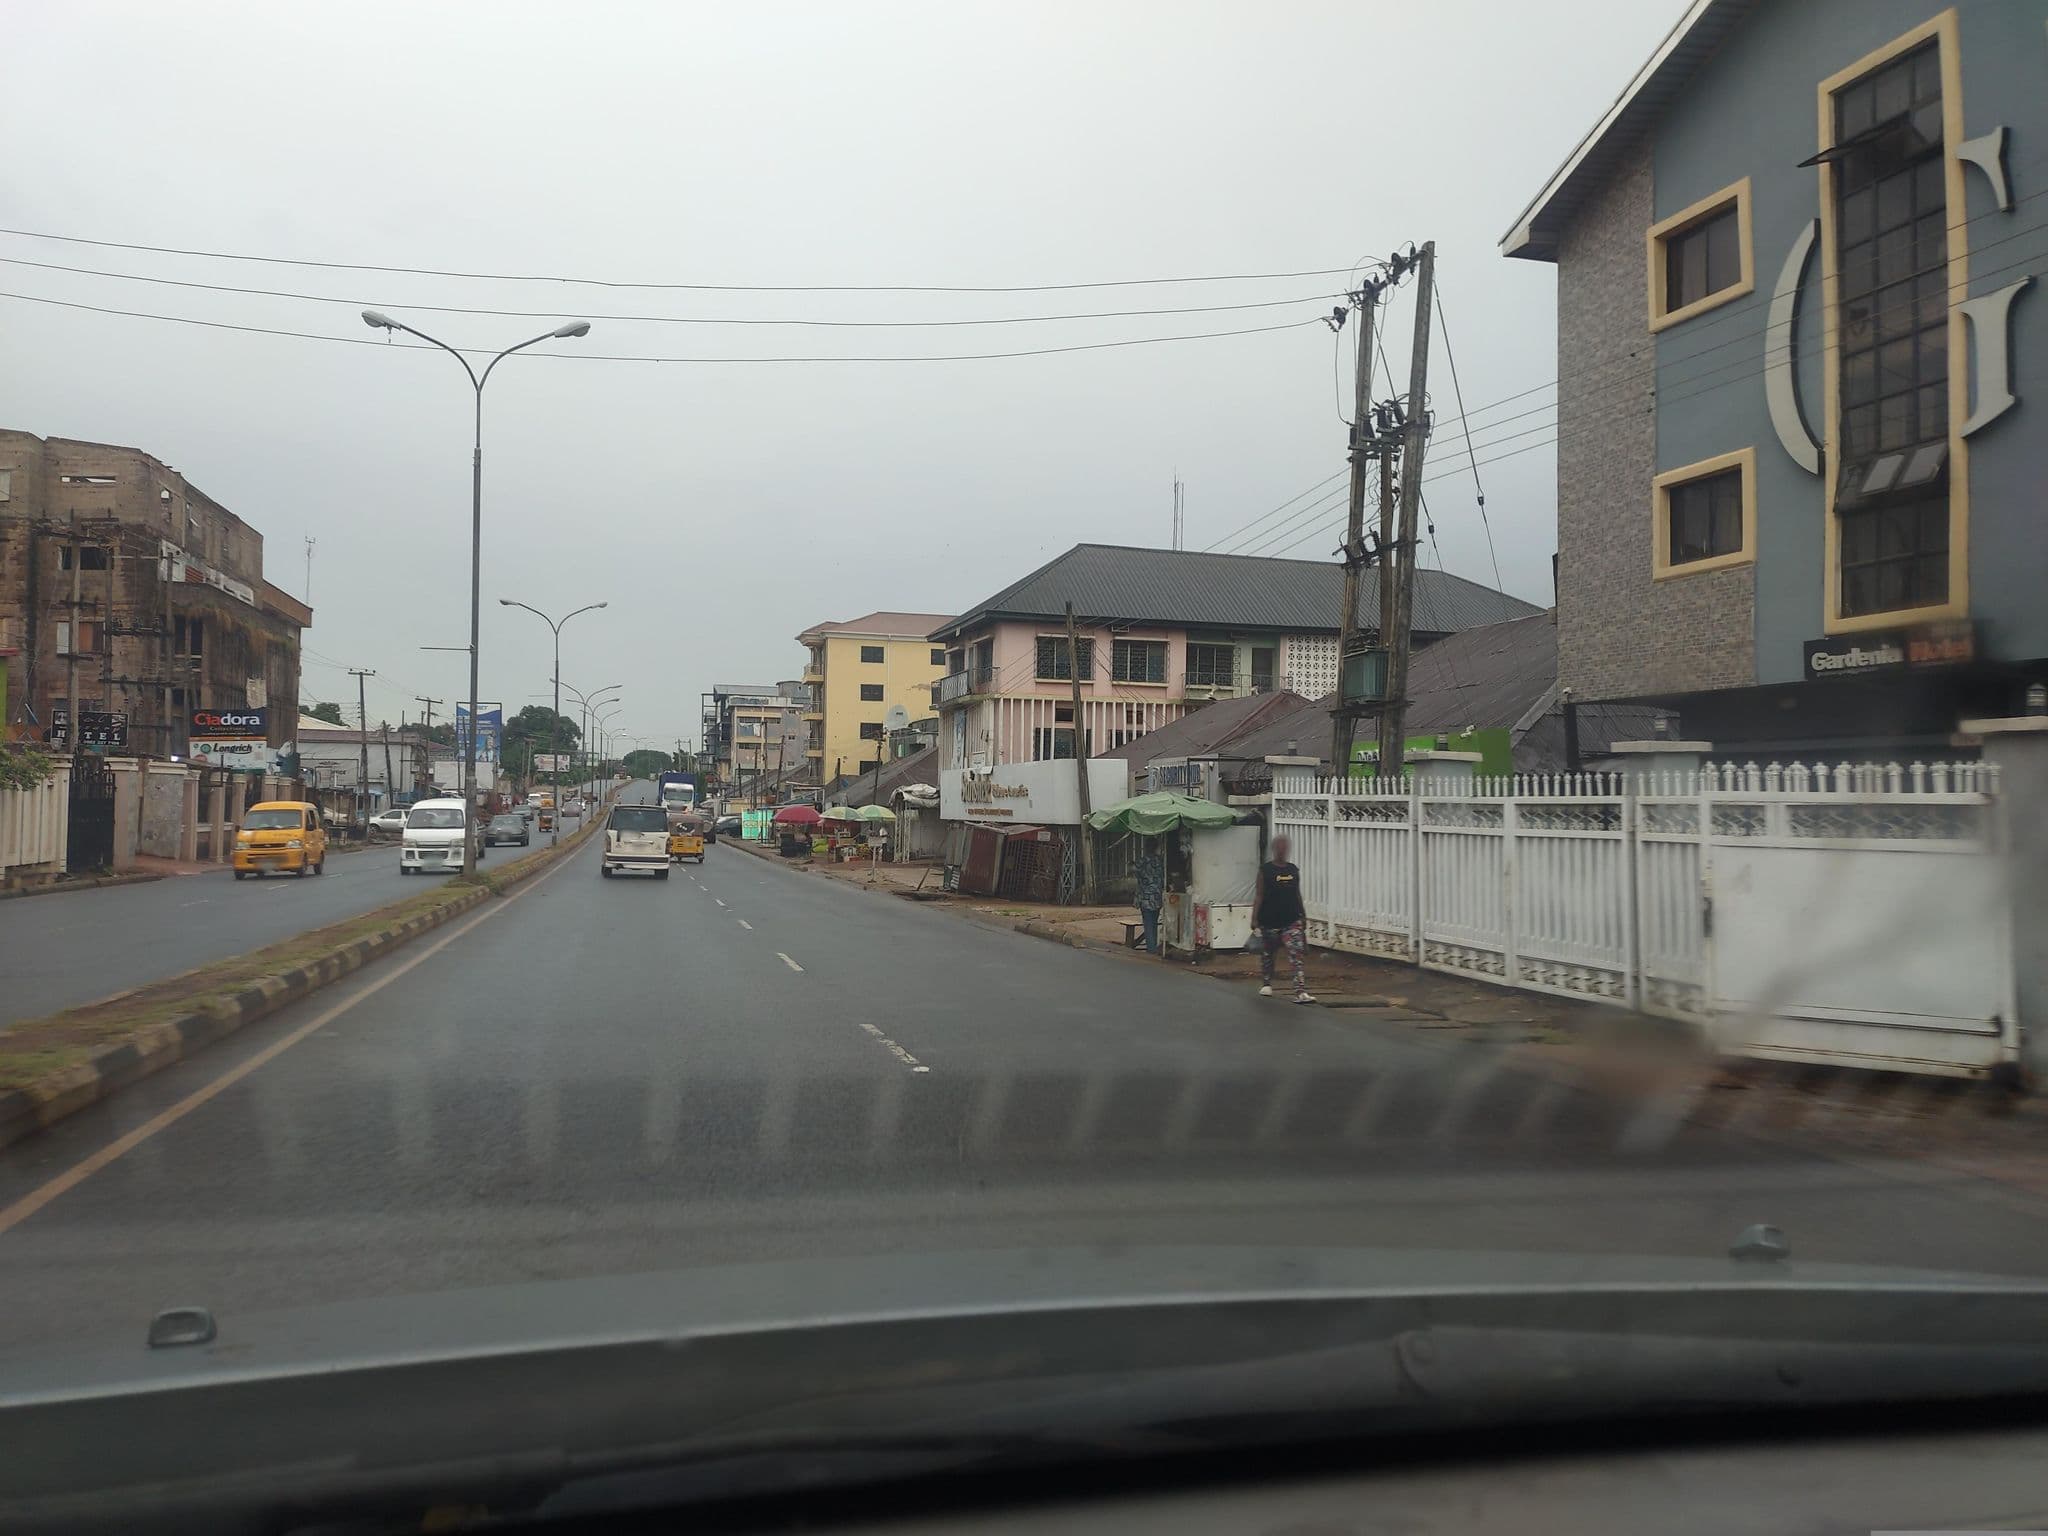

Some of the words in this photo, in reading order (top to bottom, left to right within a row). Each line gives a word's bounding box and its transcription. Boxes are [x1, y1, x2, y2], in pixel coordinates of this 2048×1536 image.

[1811, 644, 1904, 671] Gardenia
[56, 729, 121, 741] HTEL
[213, 743, 253, 754] Longrich
